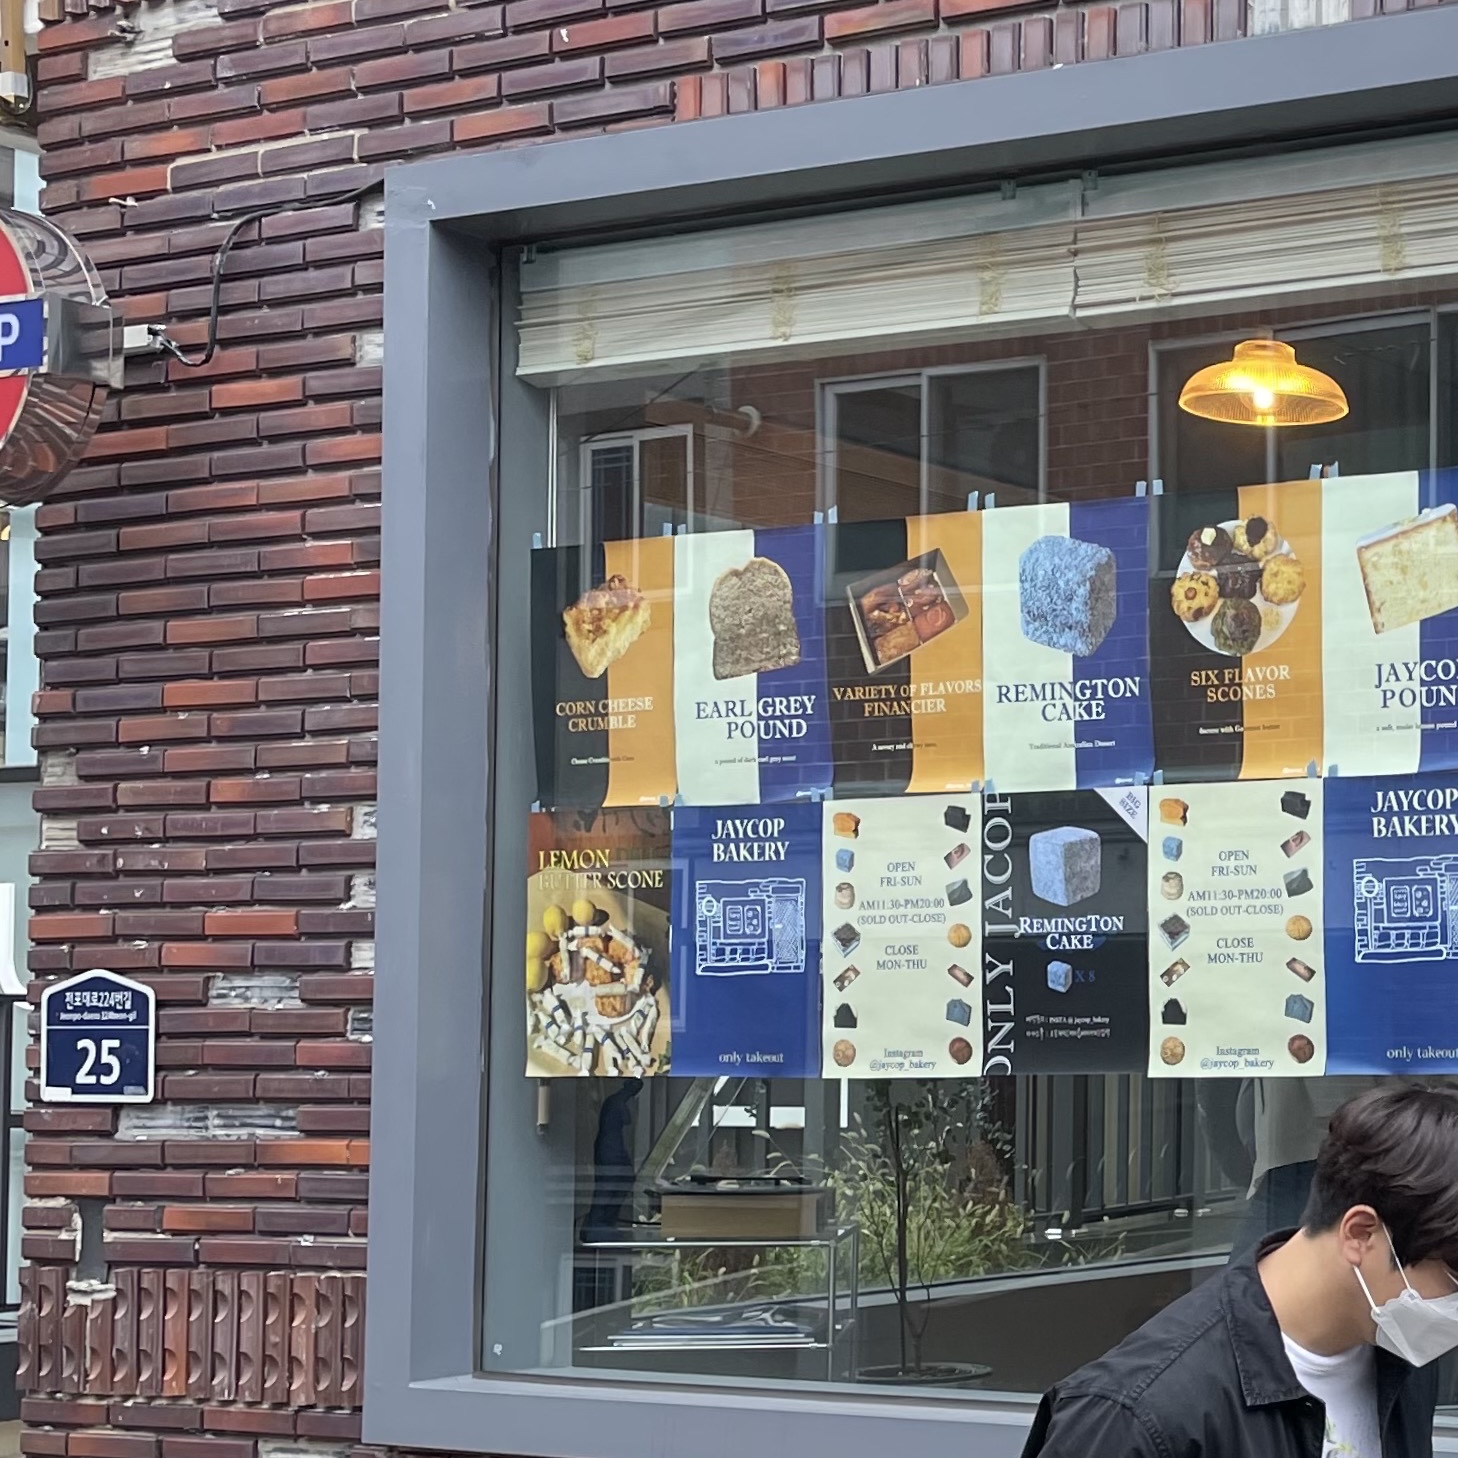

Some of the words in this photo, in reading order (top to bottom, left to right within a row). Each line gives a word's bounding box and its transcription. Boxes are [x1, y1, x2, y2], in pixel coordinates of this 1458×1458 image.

[1191, 669, 1218, 686] SIX
[1223, 665, 1291, 684] FLAVOR
[833, 685, 897, 701] VARIETY
[900, 683, 915, 698] OF
[920, 679, 982, 695] FLAVORS
[996, 677, 1140, 704] REMINGTON
[1207, 684, 1276, 703] SCONES
[556, 700, 596, 716] CORN
[598, 697, 653, 713] CHEESE
[696, 700, 753, 720] EARL
[757, 695, 816, 716] GREY
[864, 698, 946, 717] FINANCIER
[1041, 700, 1106, 721] CAKE
[568, 715, 636, 732] CRUMBLE
[727, 719, 807, 740] POUND
[1371, 788, 1458, 813] JAYCOP
[711, 818, 785, 840] JAYCOP
[539, 849, 610, 870] LEMON
[713, 841, 789, 863] BAKERY
[1219, 850, 1249, 861] OPEN
[887, 862, 915, 873] OPEN
[1211, 865, 1257, 876] FRI-SUN
[607, 870, 663, 889] SCONE
[880, 876, 922, 887] FRI-SUN
[857, 915, 886, 927] (SOLD
[888, 913, 946, 925] OUT-CLOSE)
[1187, 906, 1218, 918] (SOLD
[1220, 904, 1284, 916] OUT-CLOSE)
[1019, 915, 1124, 933] REMINGTON
[885, 944, 919, 956] CLOSE
[1046, 934, 1094, 950] CAKE
[1217, 937, 1254, 949] CLOSE
[876, 959, 927, 970] MON-THU
[1207, 952, 1263, 964] MON-THU
[983, 953, 1014, 1076] ONLY
[719, 1053, 743, 1067] only
[746, 1052, 784, 1064] takeout
[884, 1048, 924, 1060] Instagram
[1216, 1046, 1260, 1058] Instagram
[1387, 1047, 1413, 1061] only
[75, 1038, 121, 1085] 25
